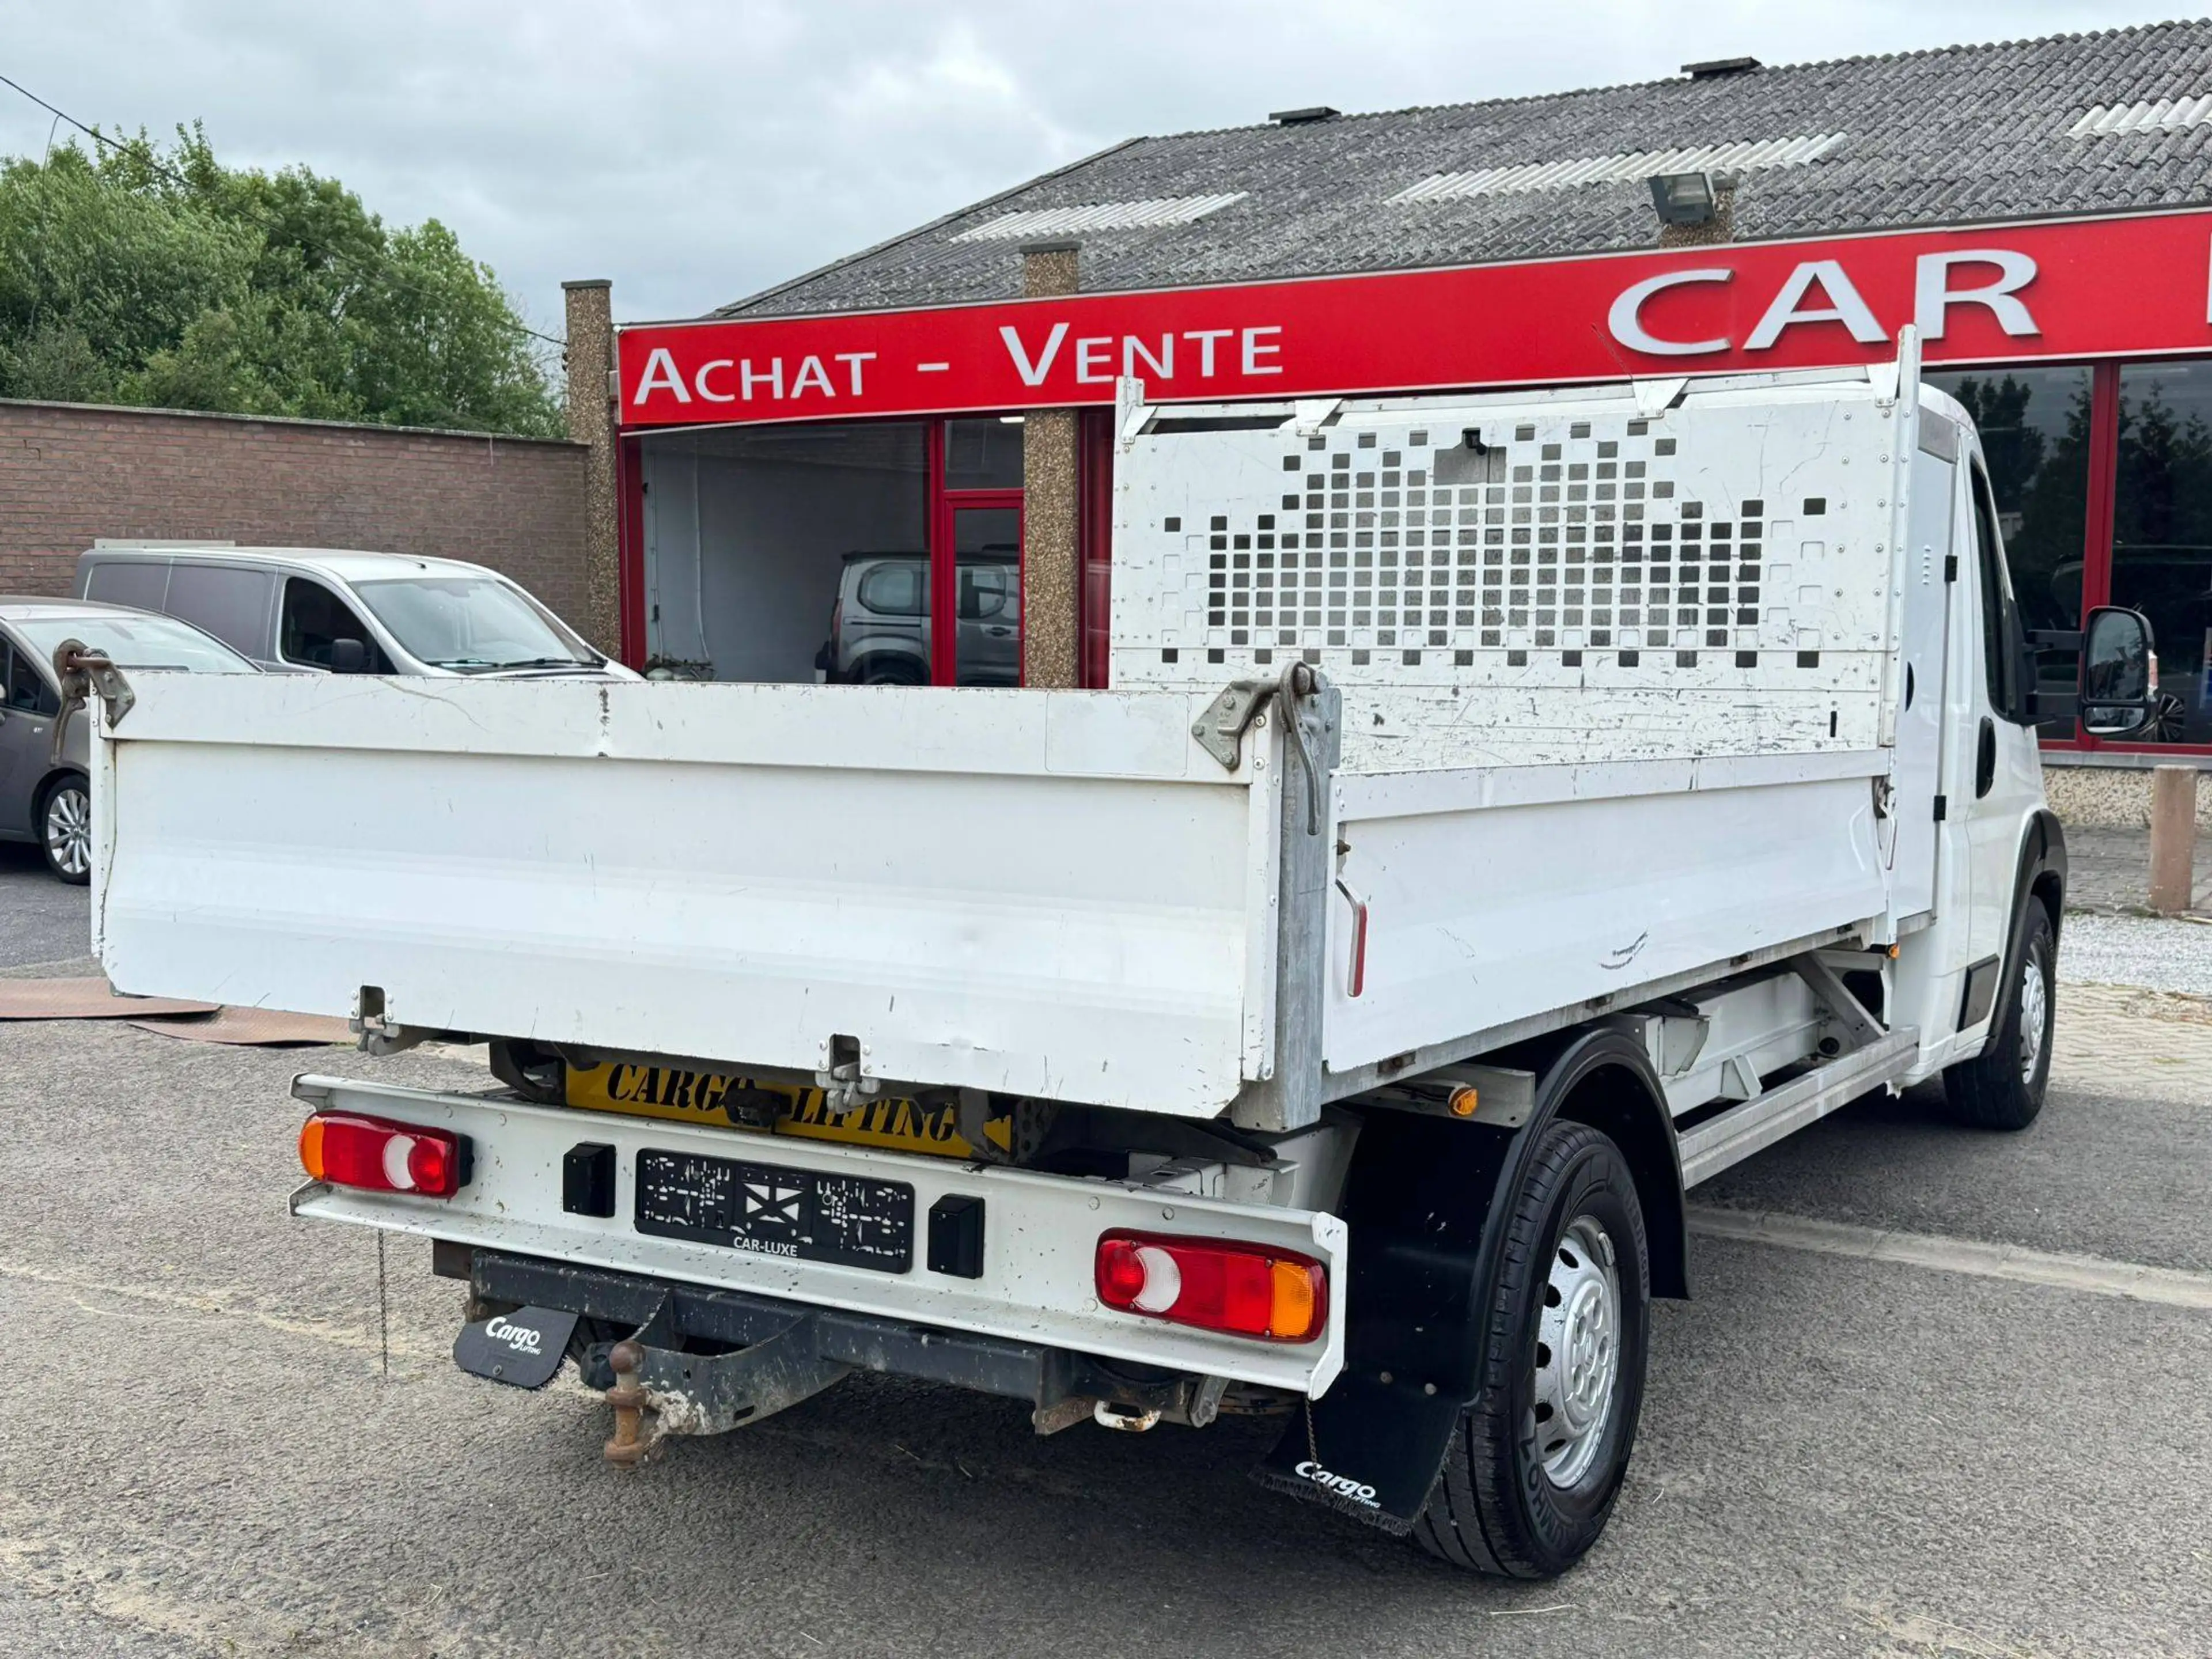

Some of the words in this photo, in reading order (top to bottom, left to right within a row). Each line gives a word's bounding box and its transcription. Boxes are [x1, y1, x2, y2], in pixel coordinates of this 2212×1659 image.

[1608, 249, 2041, 355] CAR
[634, 348, 877, 404] ACHAT
[917, 362, 950, 372] -
[999, 323, 1283, 387] VENTE
[734, 1236, 798, 1257] CAR-LUXE
[486, 1316, 541, 1350] Cargo
[520, 1344, 542, 1355] LIFTING
[1295, 1461, 1377, 1498] Cargo
[1348, 1494, 1382, 1509] LIFTING
